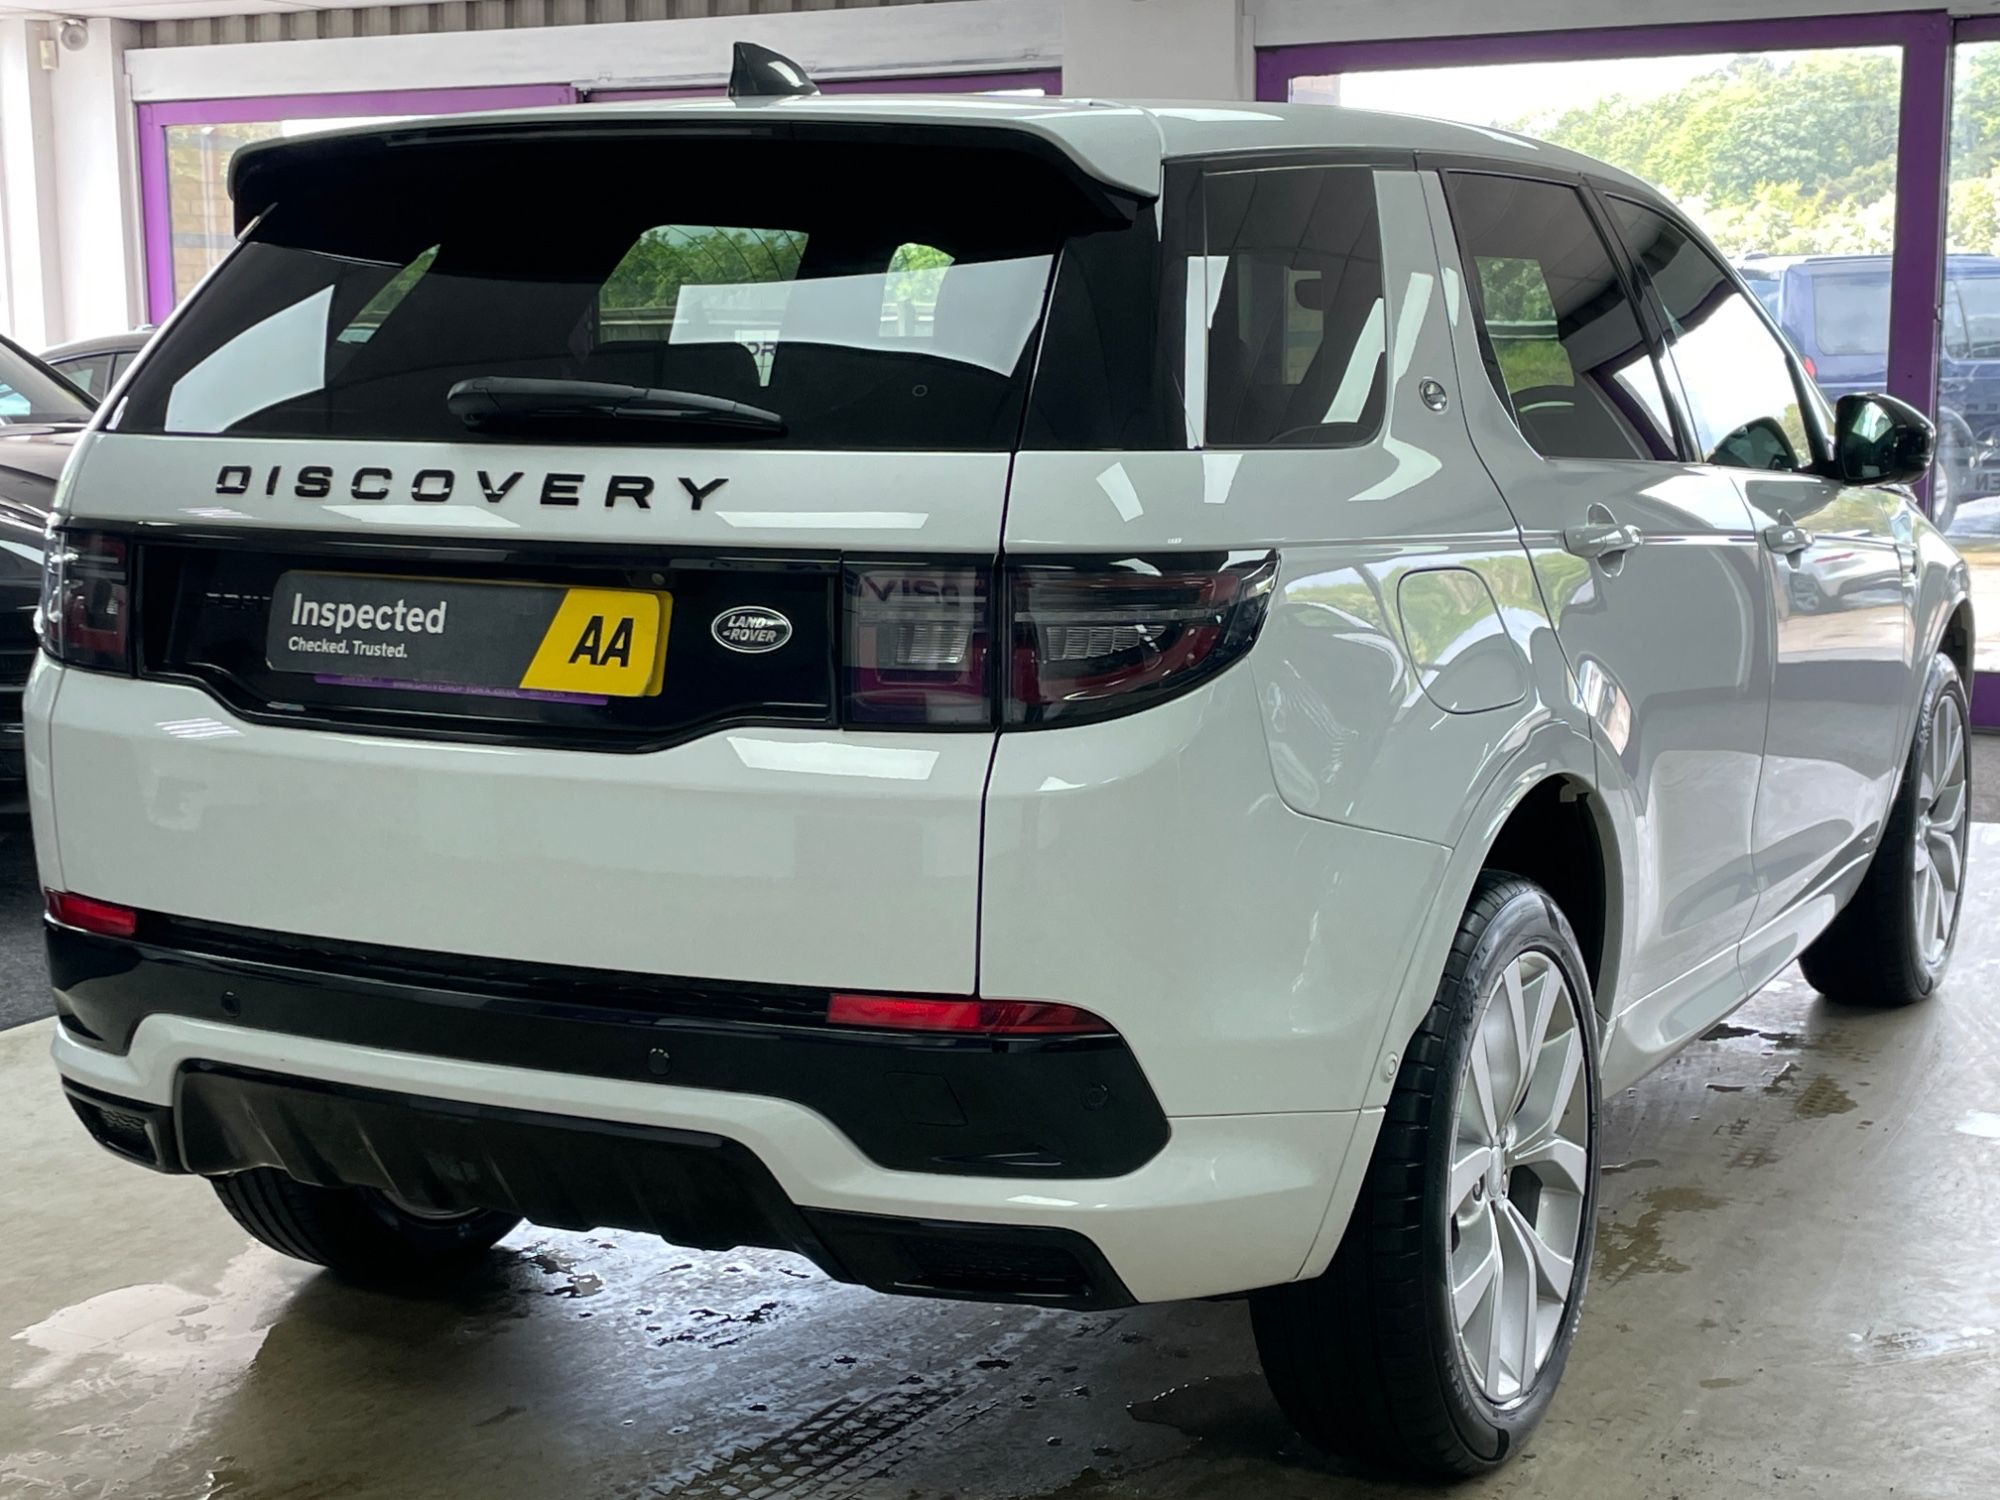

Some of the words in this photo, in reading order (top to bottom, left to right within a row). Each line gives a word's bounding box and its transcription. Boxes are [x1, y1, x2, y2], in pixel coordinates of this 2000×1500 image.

[215, 465, 730, 511] DISCOVERY
[291, 592, 447, 634] Inspected
[727, 615, 767, 629] LAND
[288, 636, 350, 655] Checked.
[353, 640, 408, 658] Trusted.
[567, 615, 634, 668] AA
[729, 628, 777, 643] ROVER
